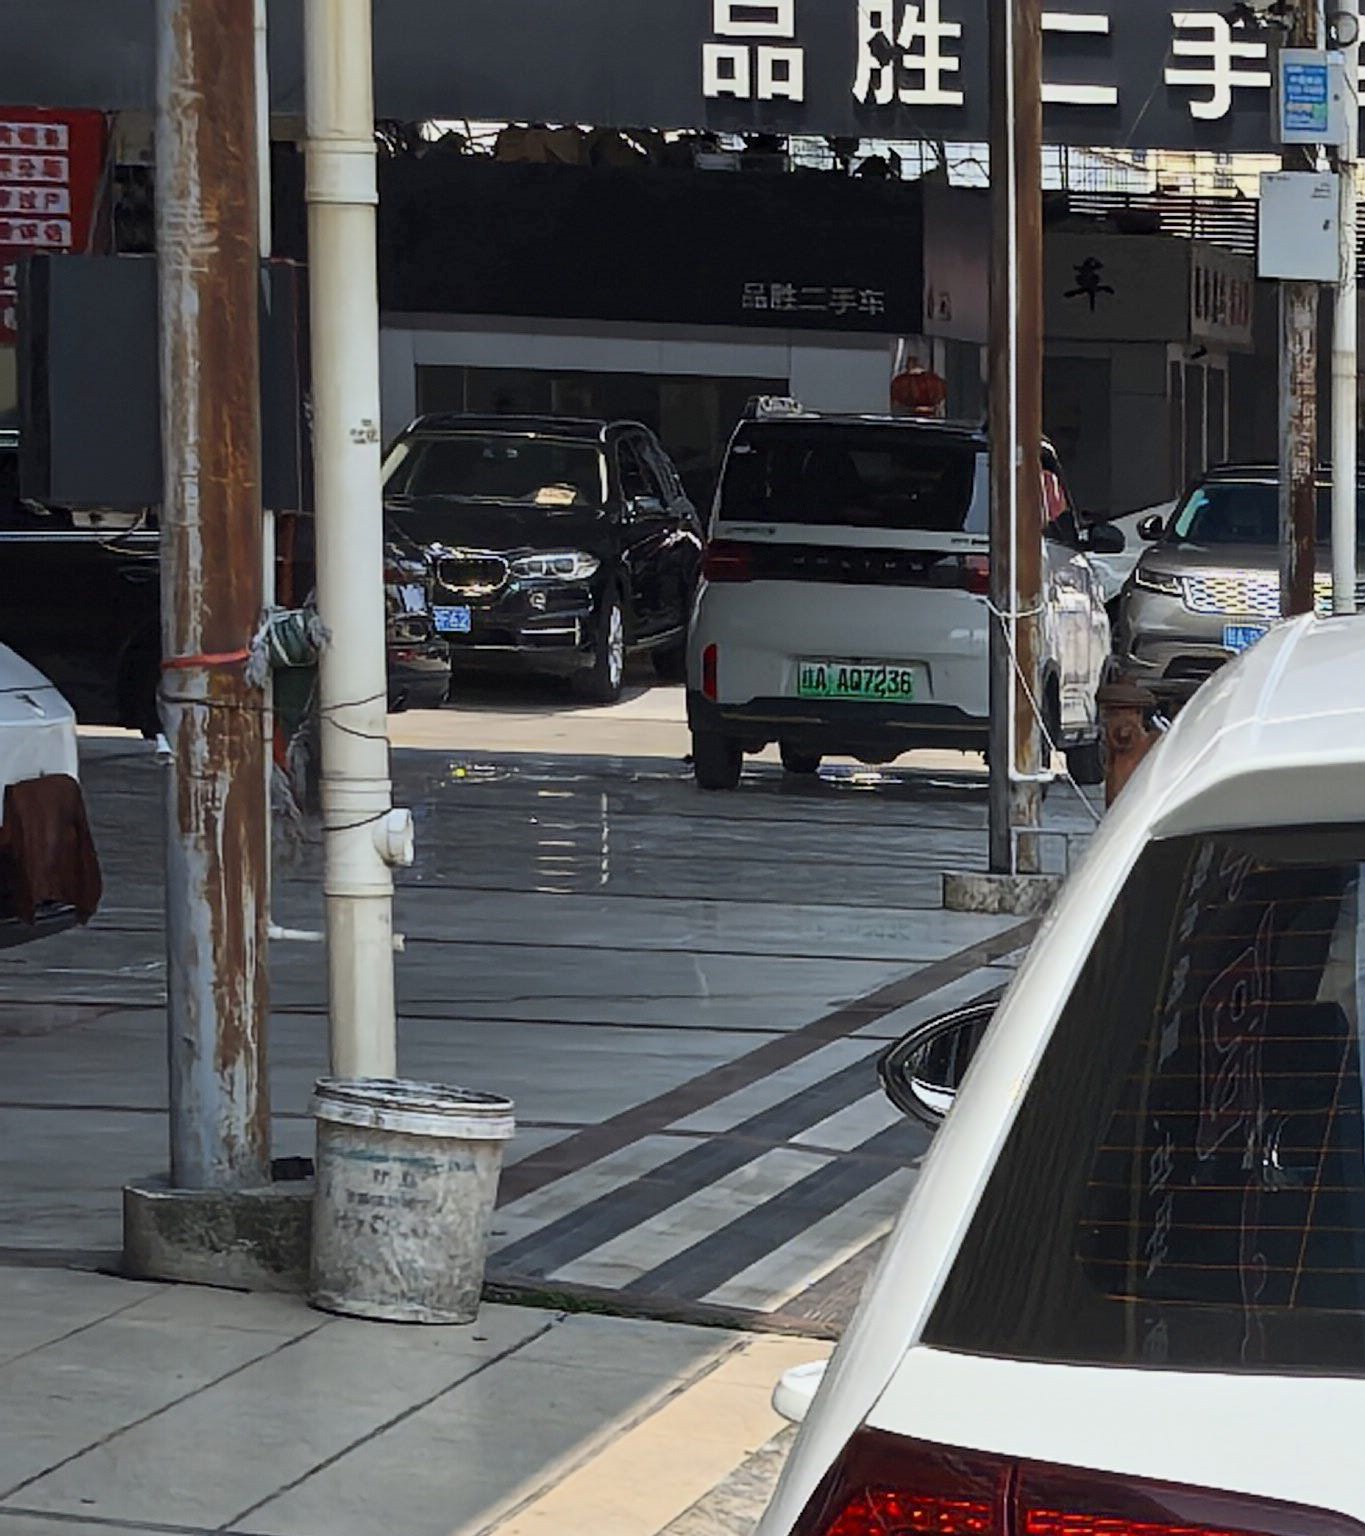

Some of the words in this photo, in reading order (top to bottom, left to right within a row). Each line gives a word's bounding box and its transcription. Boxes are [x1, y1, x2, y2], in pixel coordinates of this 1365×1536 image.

[741, 279, 886, 316] 品胜二手车
